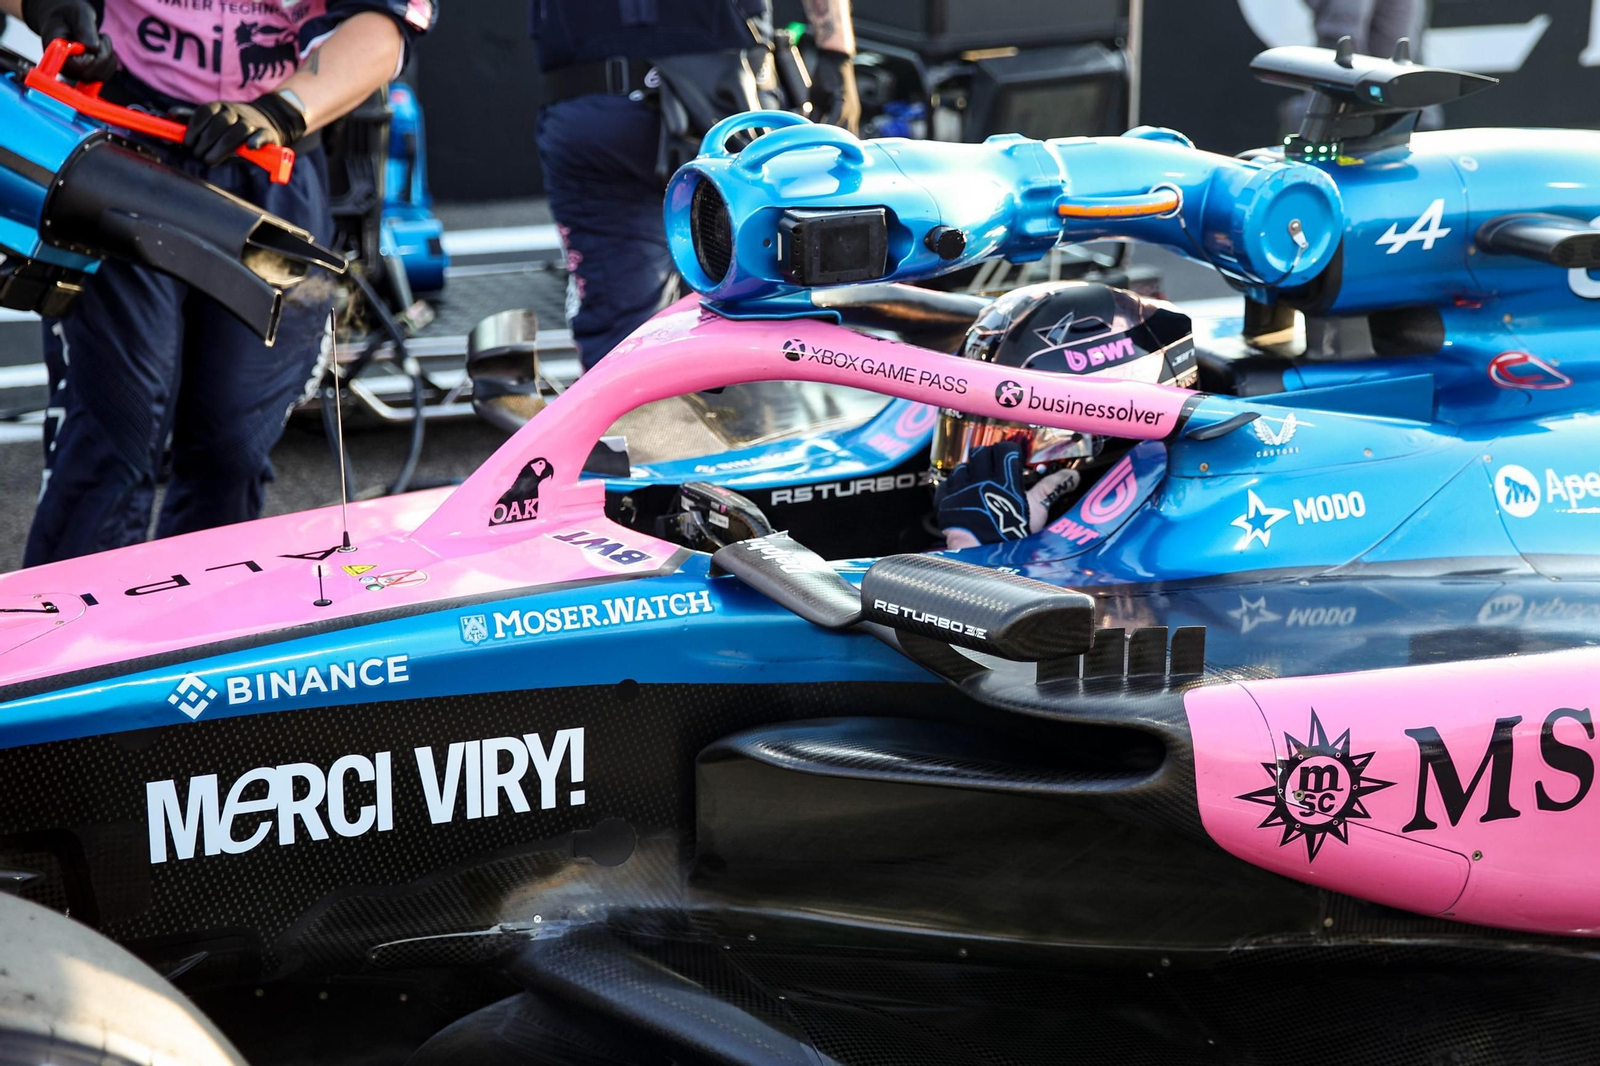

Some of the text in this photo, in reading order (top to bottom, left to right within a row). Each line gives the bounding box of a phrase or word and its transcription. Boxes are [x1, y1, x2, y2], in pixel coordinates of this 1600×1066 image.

[137, 15, 222, 73] eni
[808, 346, 968, 395] XBOX GAME PASS
[1086, 337, 1136, 367] BWT
[1028, 386, 1165, 426] businessolver
[490, 498, 539, 524] OAK
[1293, 491, 1366, 525] MODO
[551, 531, 654, 566] BWT
[1047, 517, 1100, 546] BWT
[227, 654, 410, 705] BINANCE
[414, 726, 587, 825] VIRY!
